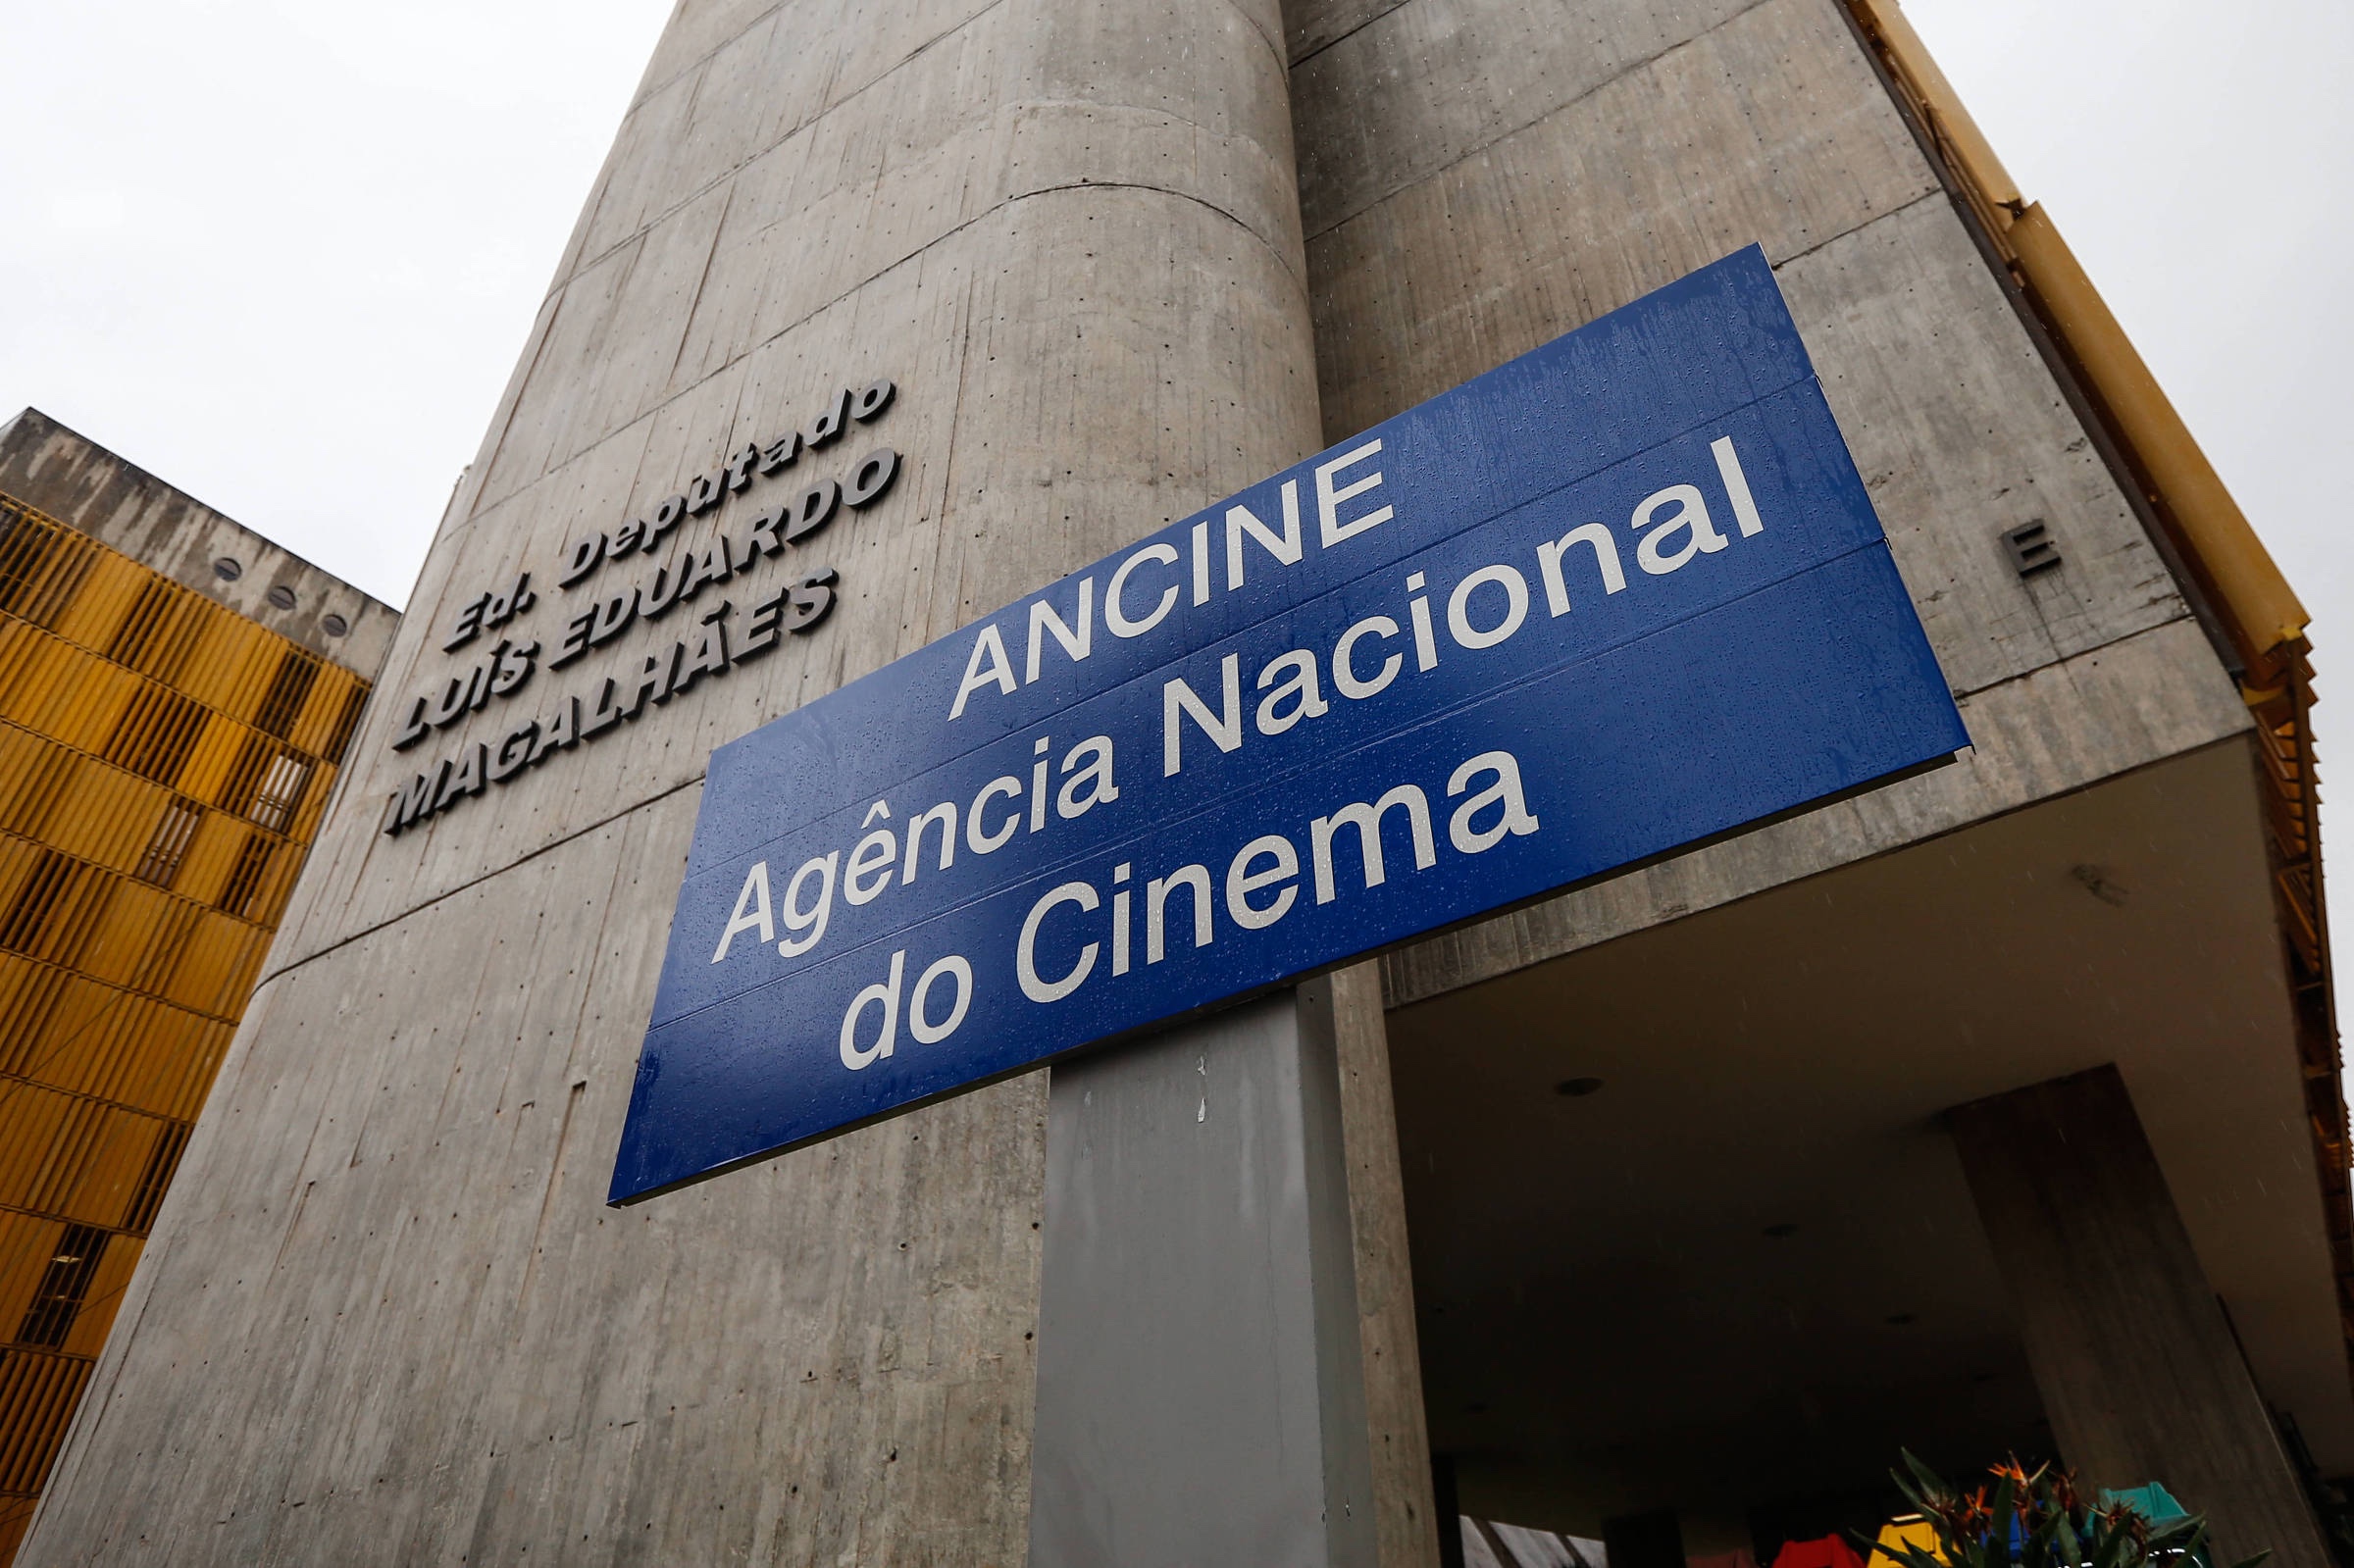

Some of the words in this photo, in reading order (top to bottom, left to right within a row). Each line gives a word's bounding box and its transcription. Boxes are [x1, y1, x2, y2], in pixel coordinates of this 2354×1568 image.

[392, 638, 540, 751] LUÍS
[549, 447, 903, 671] EDUARDO
[443, 572, 537, 653] Ed.
[558, 378, 896, 588] Deputado
[947, 438, 1395, 722] ANCINE
[384, 567, 840, 837] MAGALHÃES
[711, 733, 1118, 965] Agência
[1163, 434, 1765, 779] Nacional
[840, 950, 973, 1072] do
[1016, 750, 1540, 1004] Cinema
